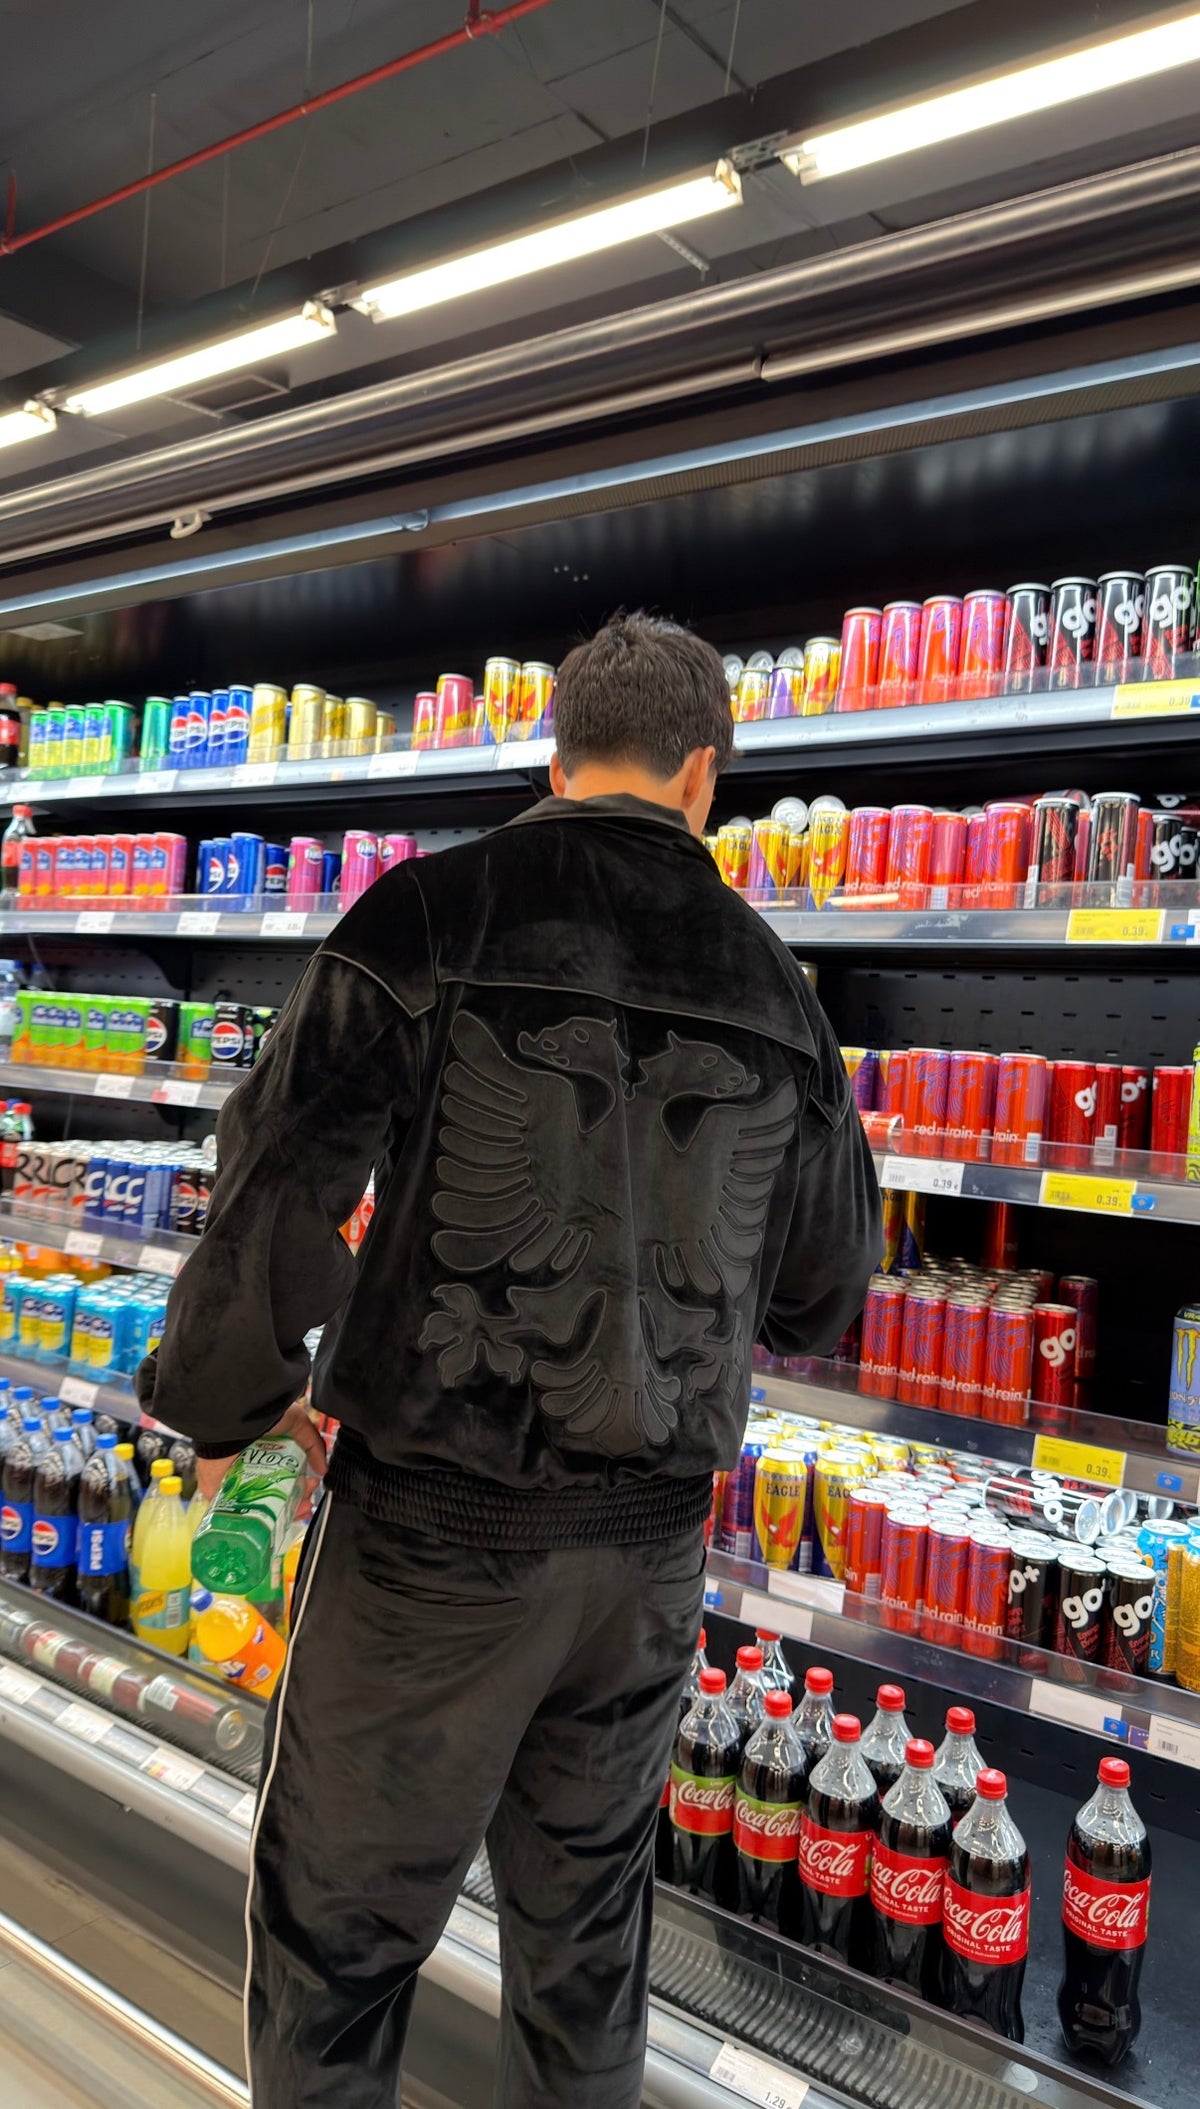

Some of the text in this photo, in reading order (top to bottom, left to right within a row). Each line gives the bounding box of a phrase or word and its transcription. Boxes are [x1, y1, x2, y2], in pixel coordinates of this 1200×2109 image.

[1086, 1463, 1108, 1477] 0.39
[766, 1482, 800, 1497] EAGLE
[90, 1529, 104, 1571] PEPSI
[815, 1873, 840, 1885] TASTE
[902, 1903, 929, 1913] TASTE
[1100, 1927, 1128, 1937] TASTE
[983, 1944, 1012, 1953] TASTE
